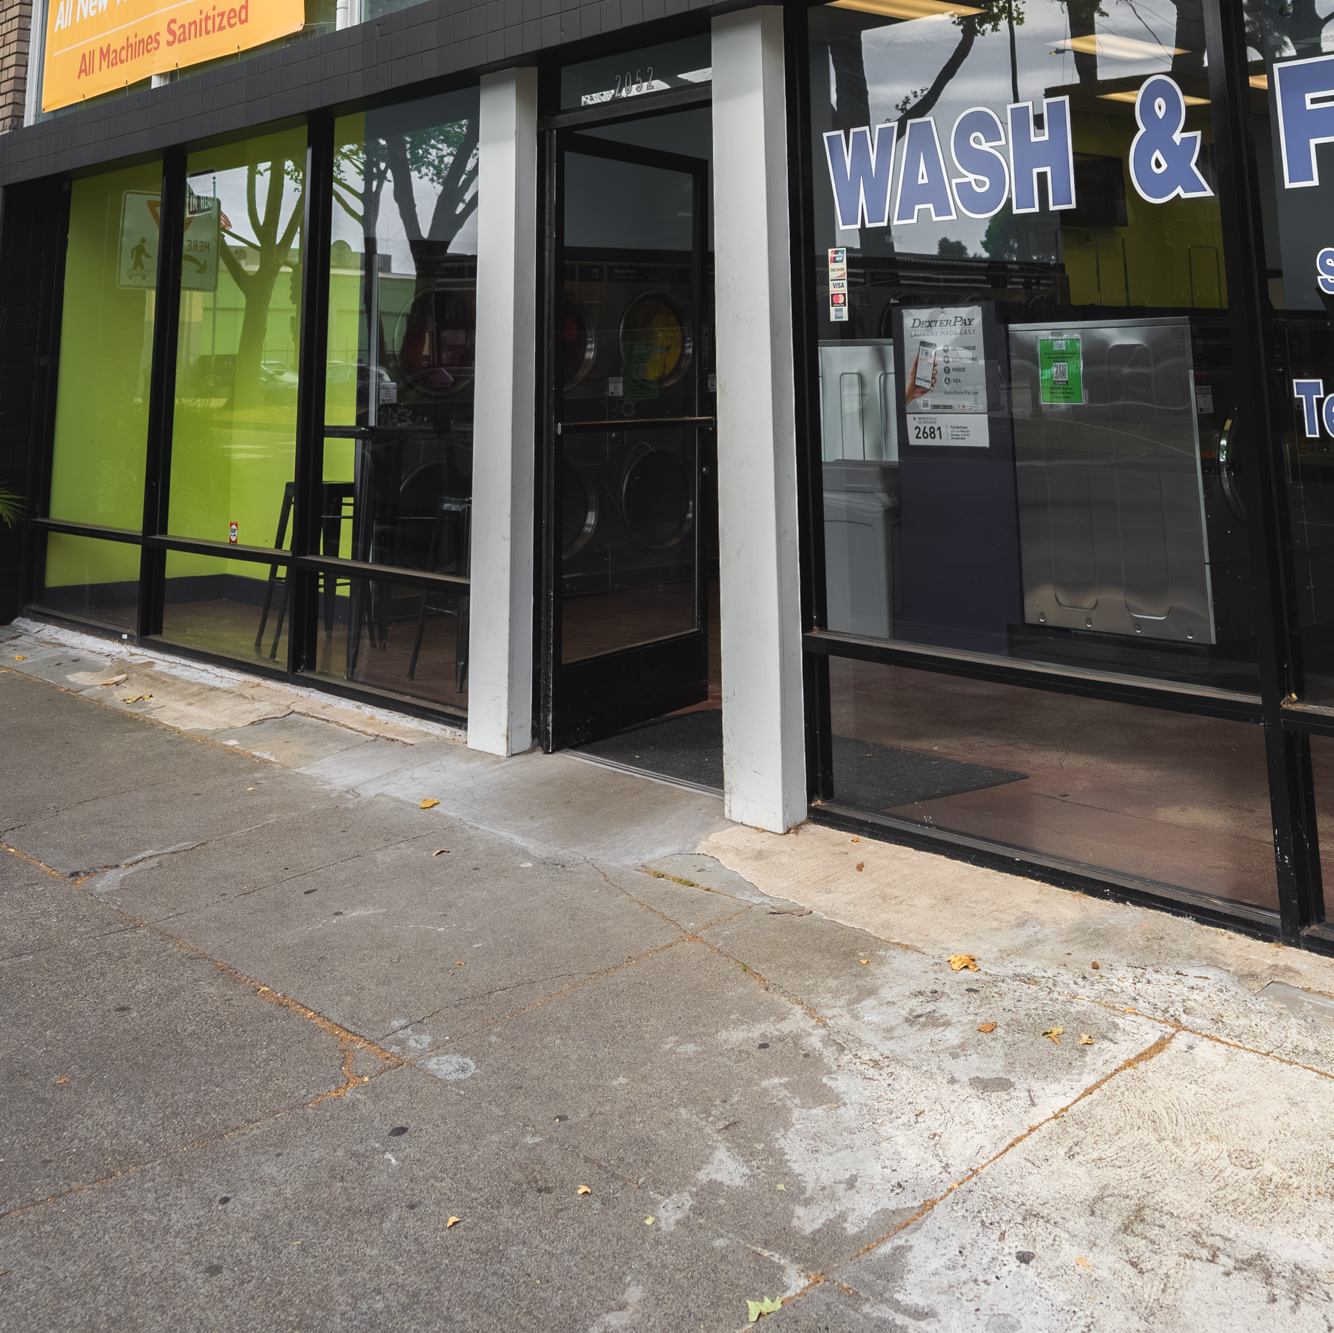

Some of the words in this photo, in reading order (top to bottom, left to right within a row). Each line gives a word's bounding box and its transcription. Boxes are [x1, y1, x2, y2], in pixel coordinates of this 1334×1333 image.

[77, 48, 95, 80] All
[98, 31, 161, 71] Machines
[614, 66, 655, 98] 2052
[821, 94, 1077, 231] WASH
[1126, 73, 1216, 206] &
[909, 329, 939, 338] LAUNDRY
[959, 328, 976, 336] EASY
[914, 425, 943, 440] 2681
